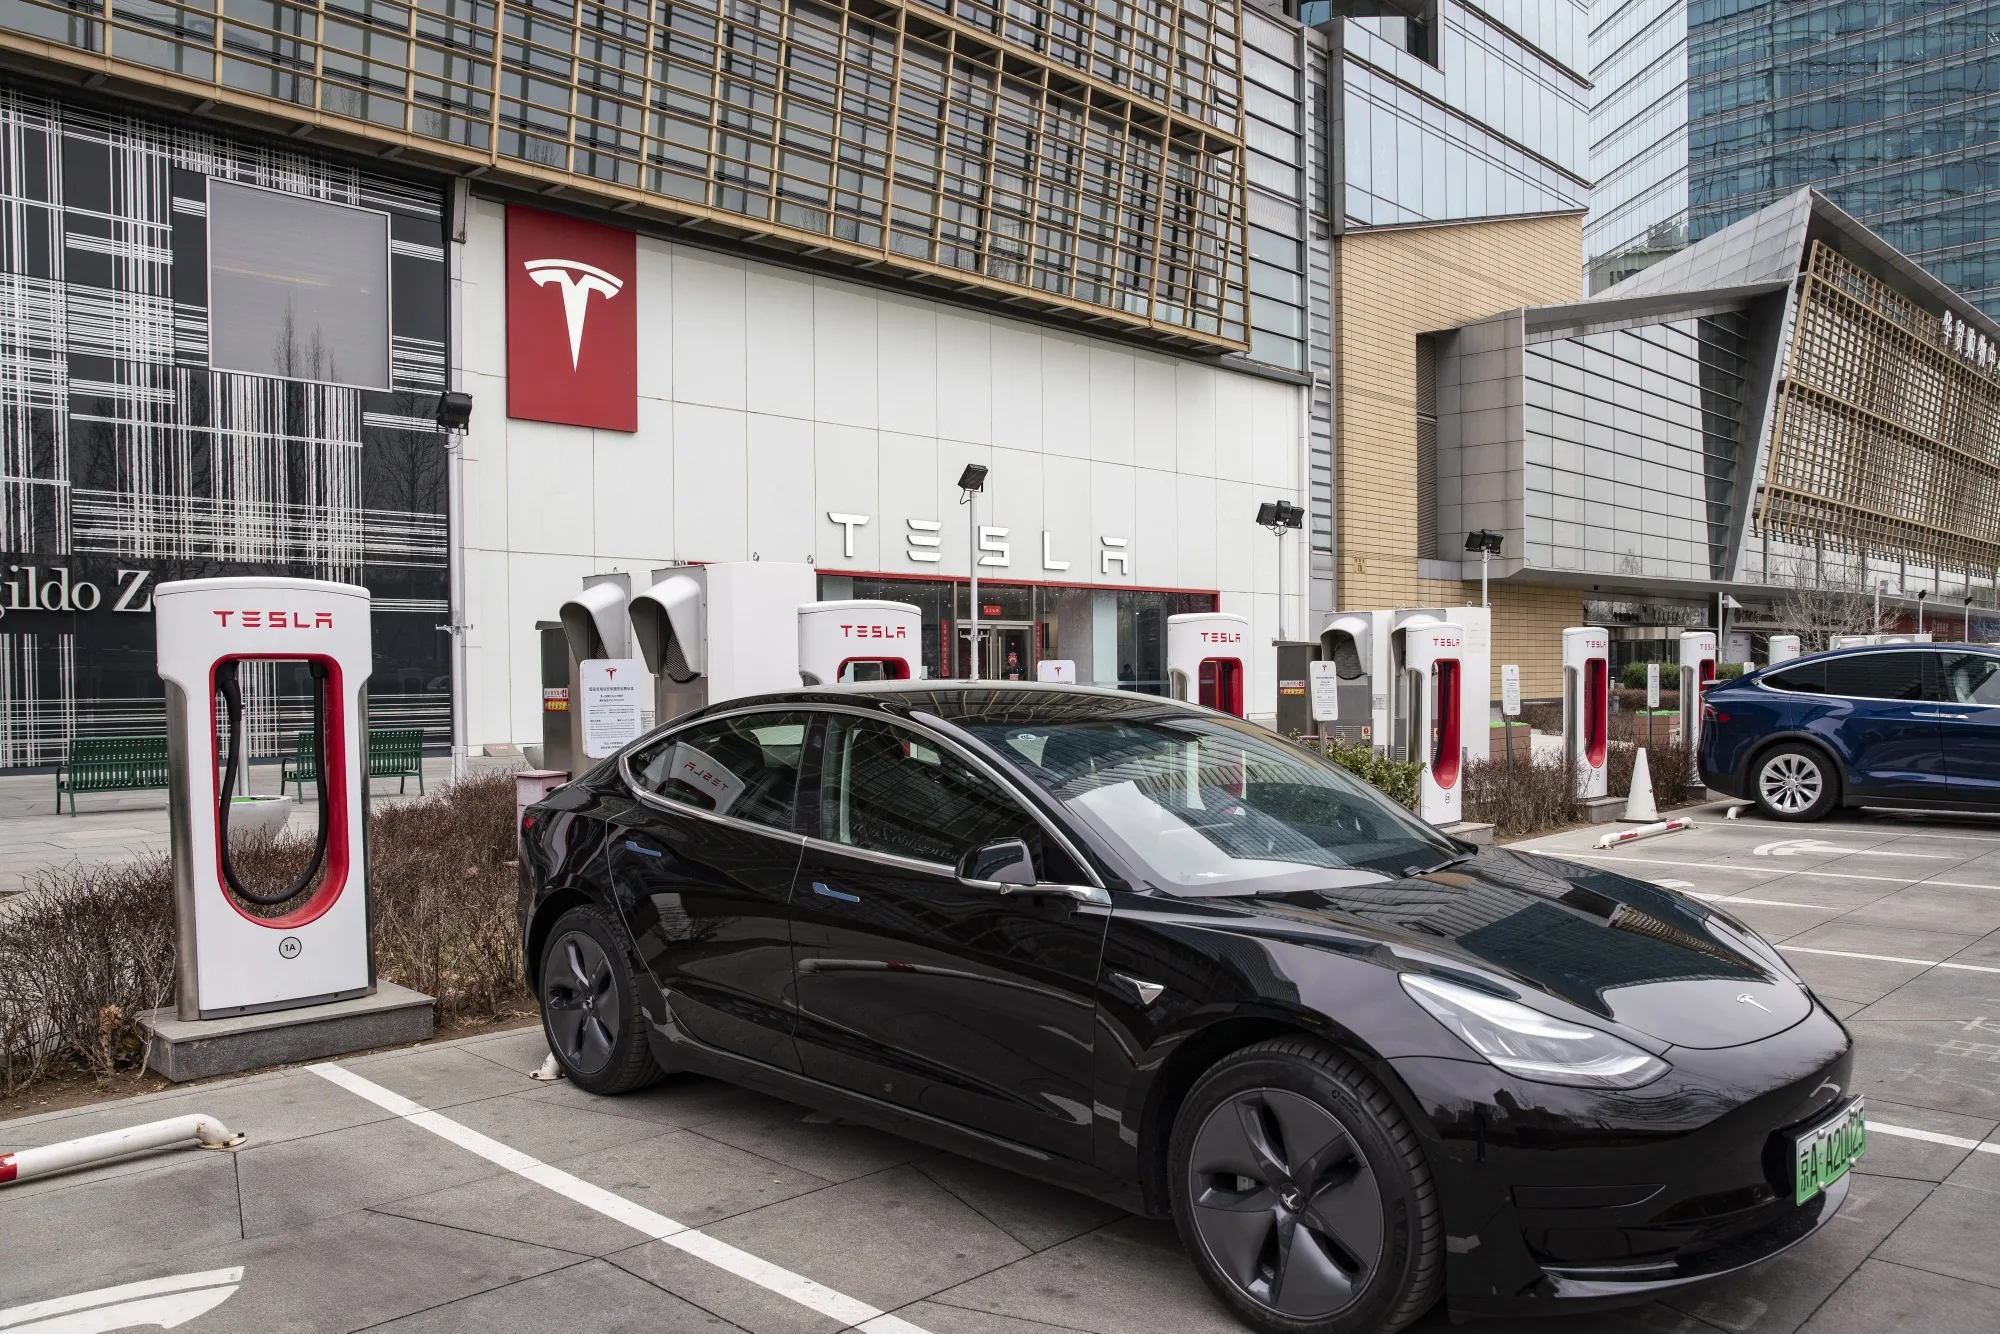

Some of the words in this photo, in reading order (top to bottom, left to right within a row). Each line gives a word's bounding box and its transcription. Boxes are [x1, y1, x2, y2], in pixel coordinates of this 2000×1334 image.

[1942, 309, 2000, 374] 华贸购物中
[827, 511, 1129, 575] TESLA
[212, 610, 333, 629] TESLA
[840, 625, 906, 638] TESLA
[1200, 632, 1241, 643] TESLA
[1433, 638, 1460, 647] TESLA
[284, 943, 297, 952] 1A
